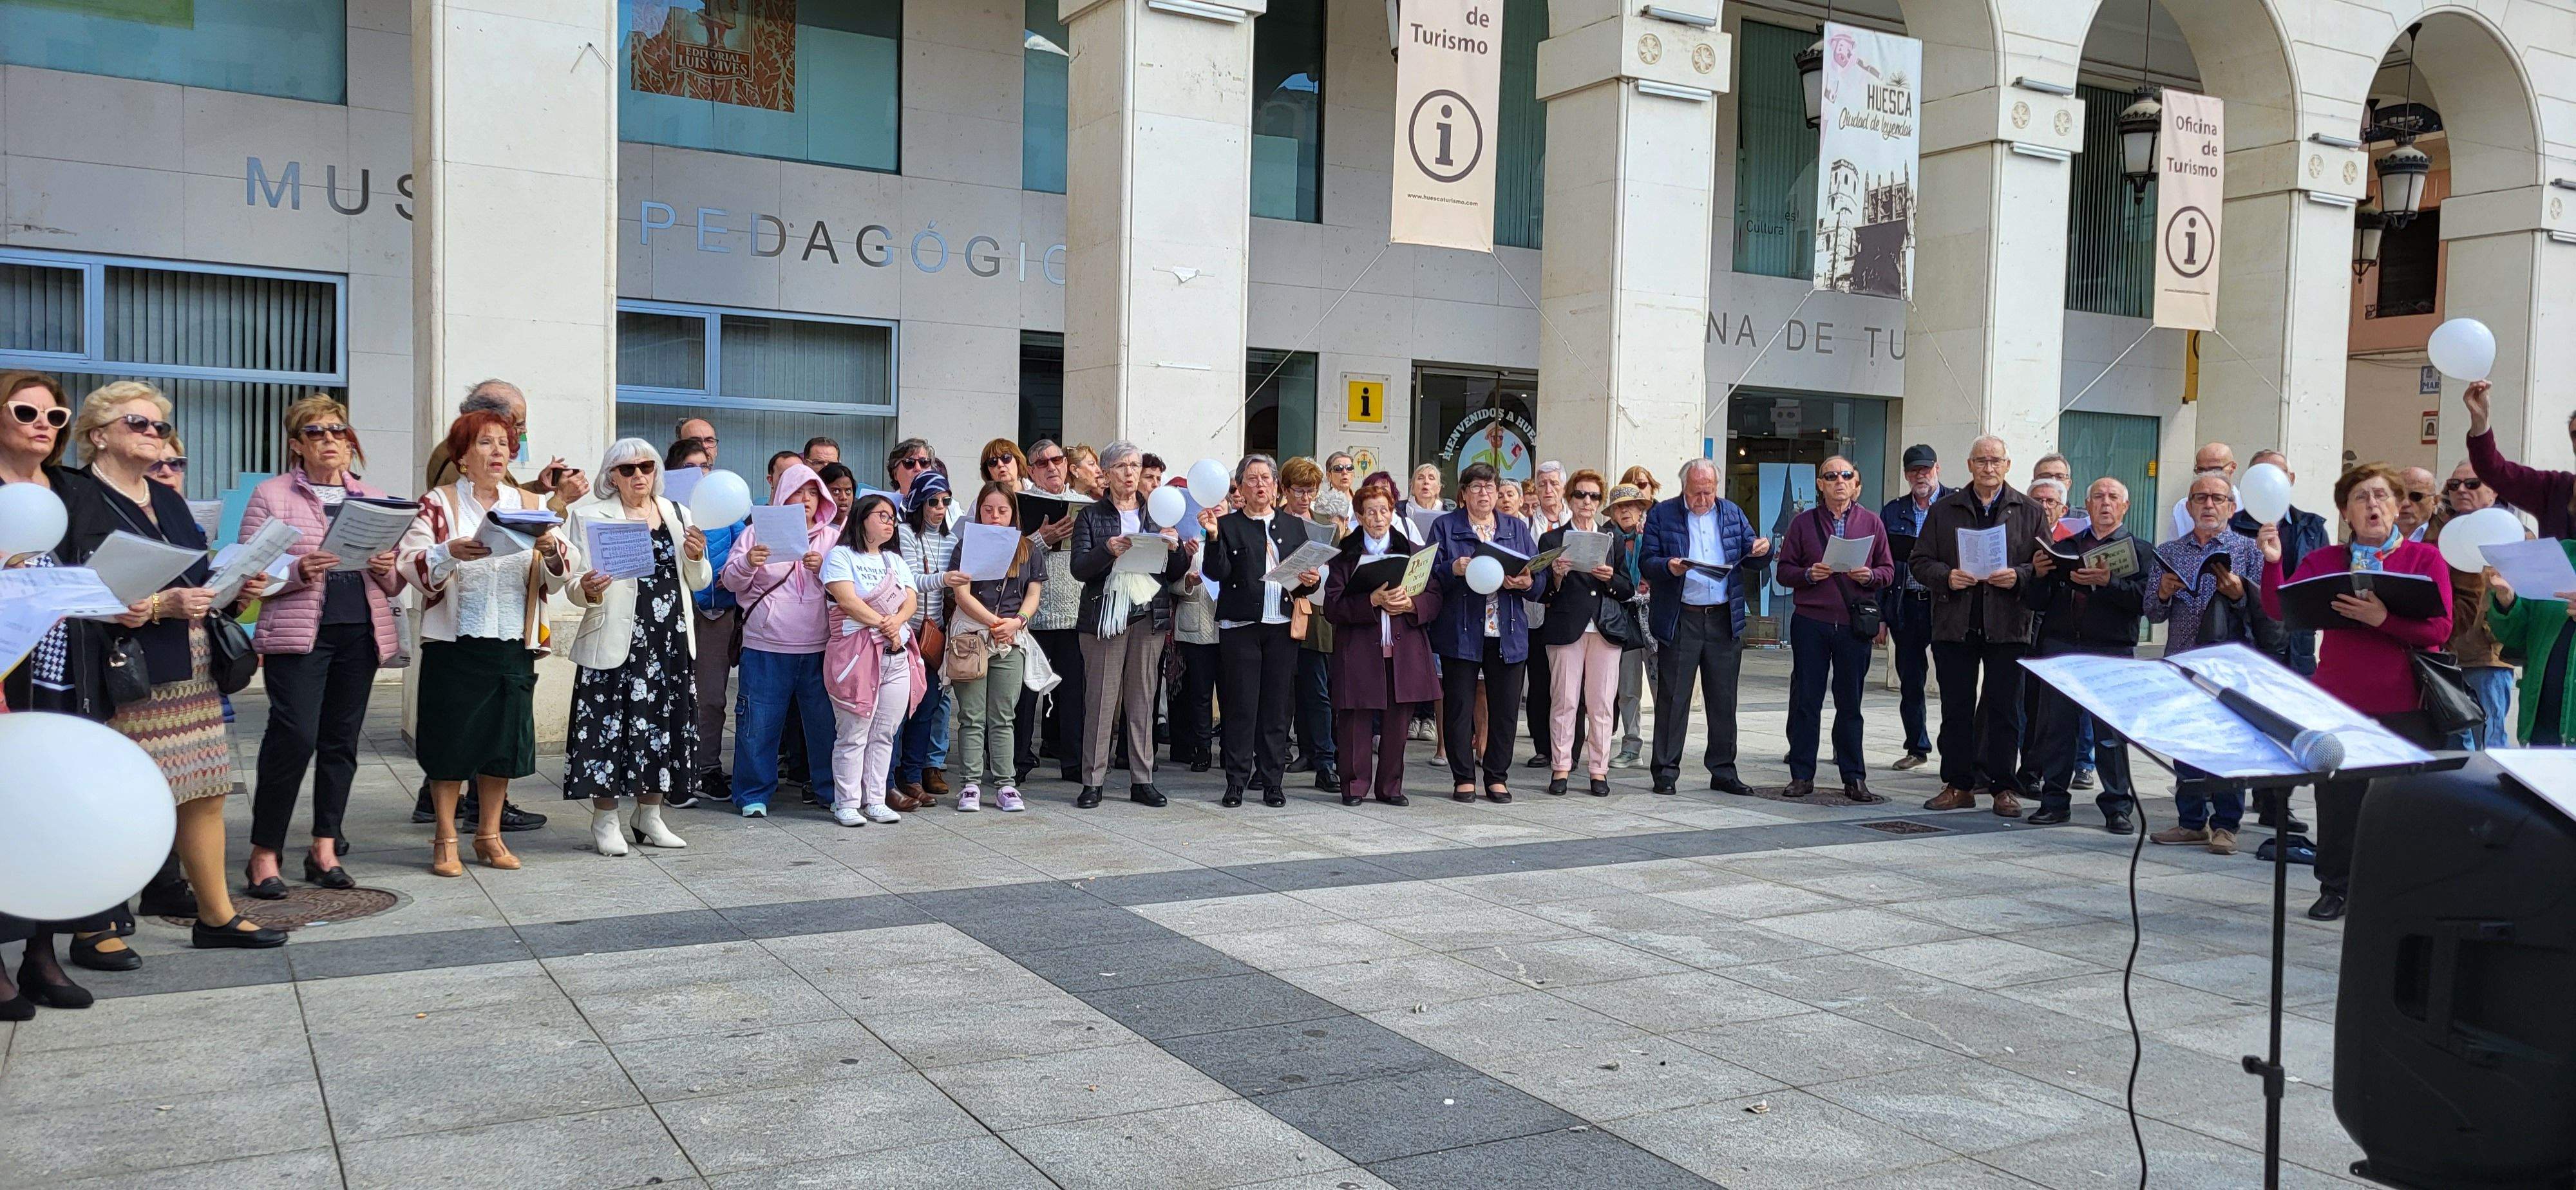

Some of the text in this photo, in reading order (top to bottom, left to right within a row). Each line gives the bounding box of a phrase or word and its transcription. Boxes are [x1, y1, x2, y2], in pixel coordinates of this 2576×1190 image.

[1466, 6, 1490, 28] de
[1410, 23, 1488, 55] Turismo
[678, 54, 747, 75] LUIS VIVES
[685, 46, 741, 63] EDITORIAL
[1867, 84, 1912, 118] HUESCA
[1839, 107, 1913, 140] Ciudad de leyendas
[2176, 115, 2217, 136] Oficina
[2202, 140, 2217, 156] de
[2166, 156, 2217, 178] Turismo
[1407, 193, 1478, 207] www.huescaturismo.com
[1746, 220, 1784, 235] Cultura
[1706, 311, 1757, 347] NA
[1786, 319, 1833, 354] DE
[1442, 408, 1504, 462] BIENVENIDOS
[1506, 411, 1514, 423] A
